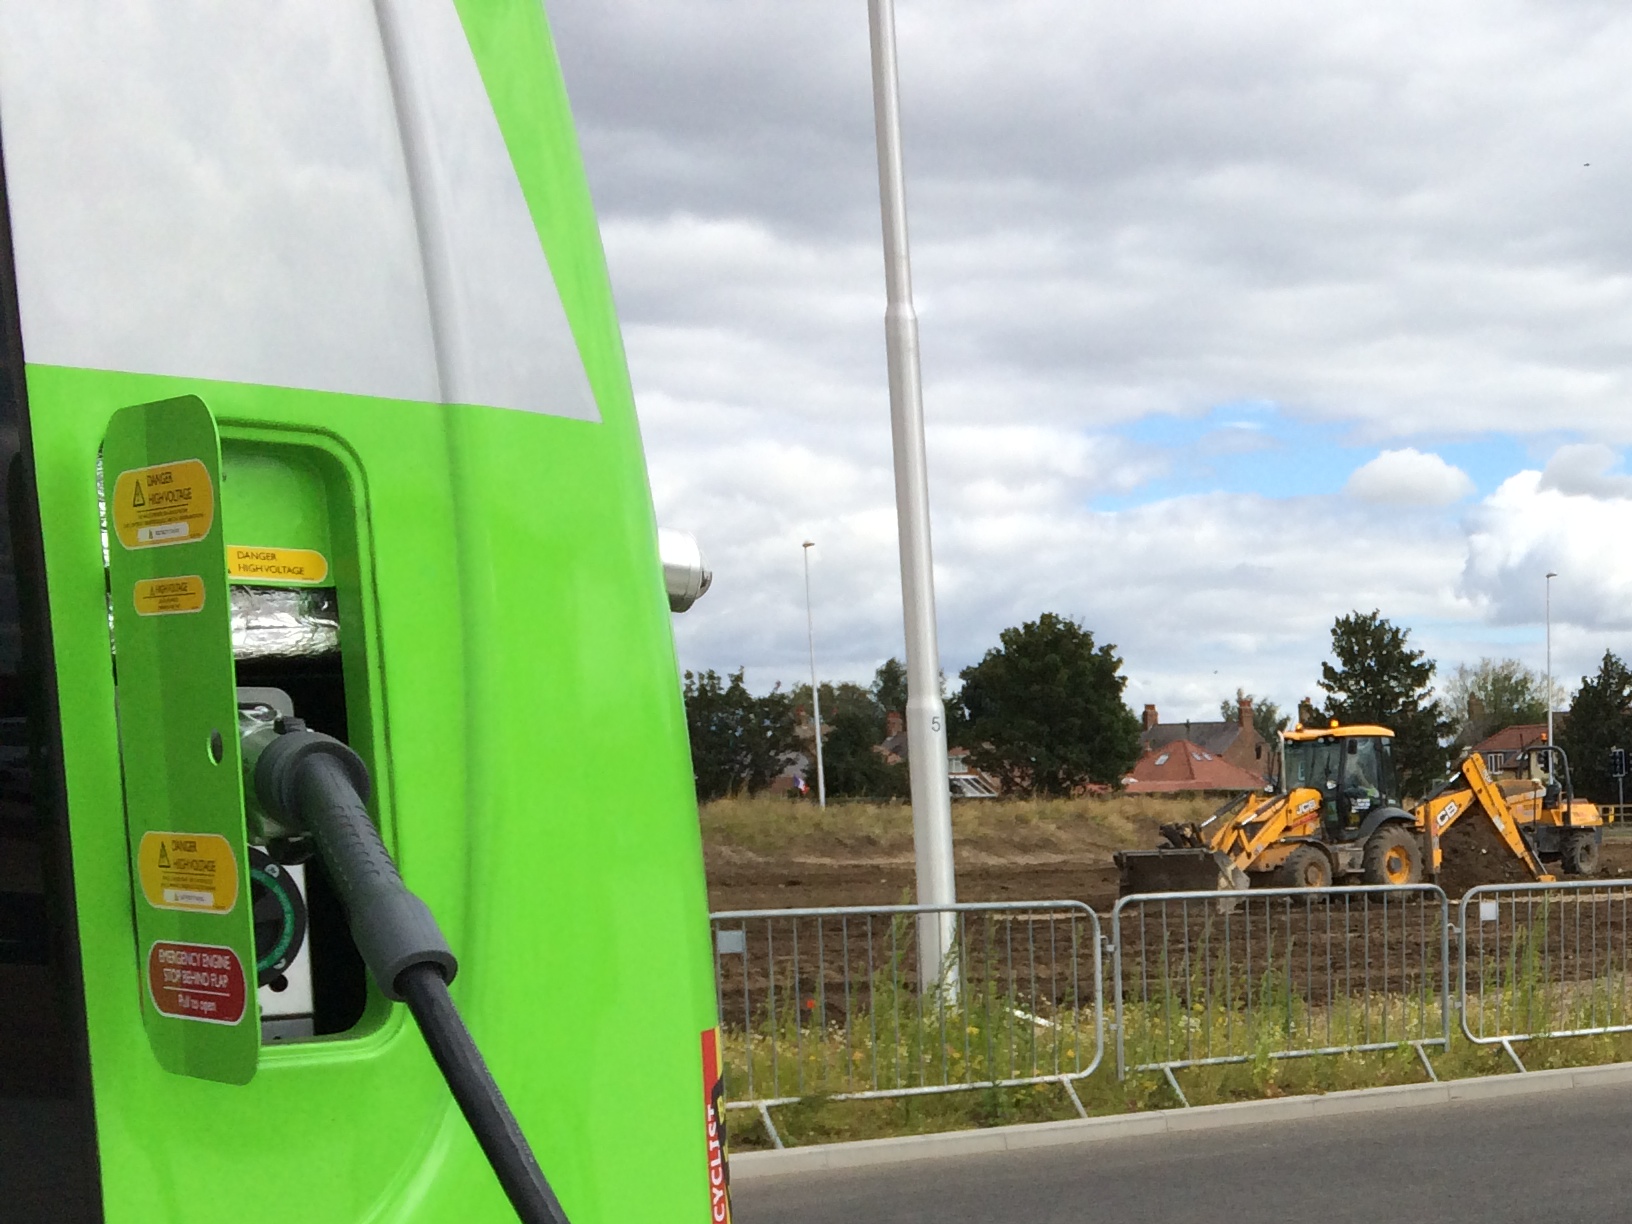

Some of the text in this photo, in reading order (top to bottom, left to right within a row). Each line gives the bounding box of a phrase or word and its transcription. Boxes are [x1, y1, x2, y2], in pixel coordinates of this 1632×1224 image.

[146, 471, 174, 487] DANGER
[148, 487, 192, 505] HIGH VOLTAGE
[236, 551, 277, 561] DANGER
[238, 564, 305, 576] HIGH VOLTAGE
[931, 716, 941, 732] 5
[1296, 800, 1316, 815] JCB
[1436, 801, 1458, 827] CB
[158, 949, 231, 970] EMERGENCY ENGINE
[163, 968, 229, 988] STOP BEHIND FLAP
[178, 994, 217, 1014] Pull to open
[707, 1104, 725, 1222] CYCLIST
